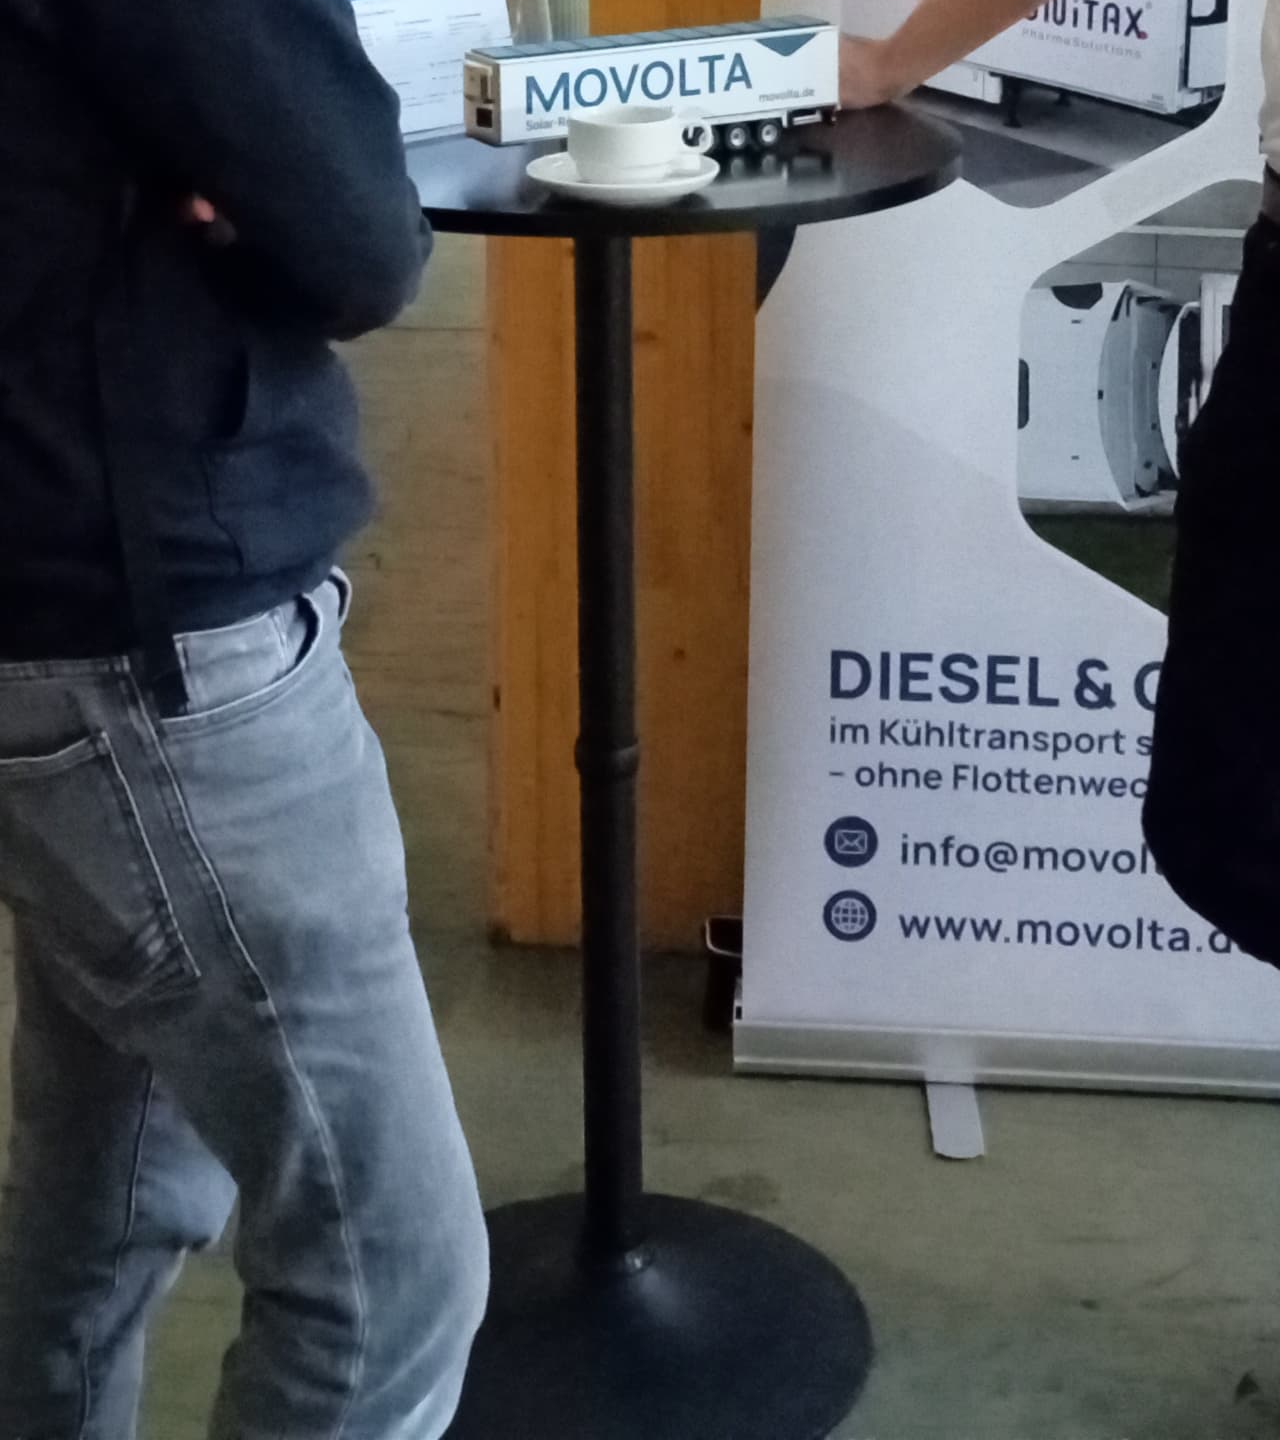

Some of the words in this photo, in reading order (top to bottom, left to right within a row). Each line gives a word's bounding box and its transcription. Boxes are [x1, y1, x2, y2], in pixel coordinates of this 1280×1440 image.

[524, 51, 753, 115] MOVOLTA
[758, 87, 816, 103] movolta.de
[525, 116, 569, 132] Solar-R
[830, 649, 1060, 708] DIESEL
[1073, 658, 1117, 711] &
[829, 716, 871, 747] im
[877, 717, 1127, 761] Kühltransport
[854, 760, 943, 791] ohne
[951, 763, 1150, 800] Flottenwec
[900, 832, 1163, 877] info@movol
[897, 911, 1239, 955] www.movolta.d
